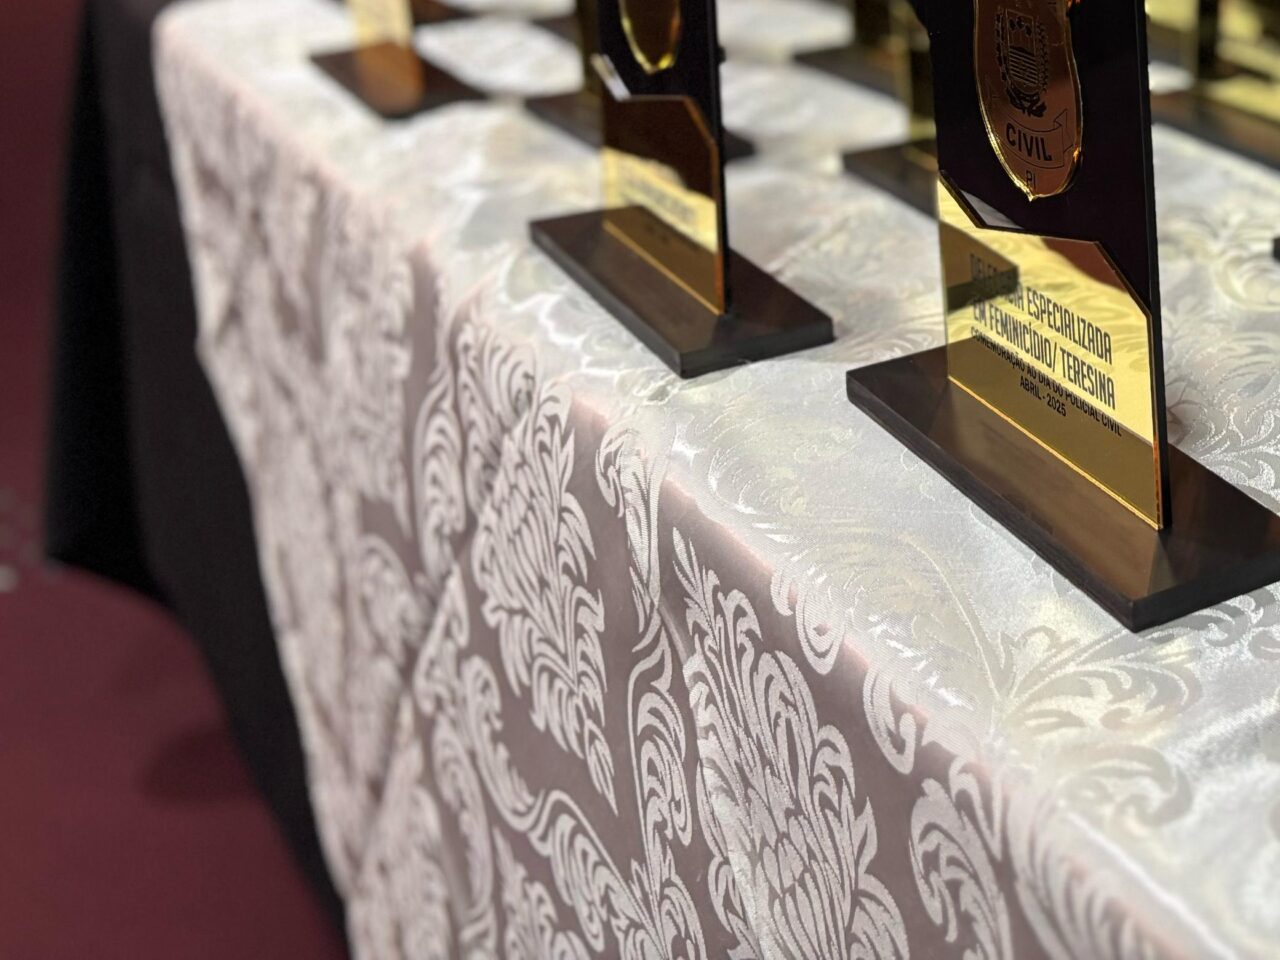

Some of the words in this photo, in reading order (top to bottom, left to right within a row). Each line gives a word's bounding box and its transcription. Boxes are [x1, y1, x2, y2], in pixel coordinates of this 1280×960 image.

[1006, 122, 1052, 162] CIVIL
[1025, 169, 1037, 190] PI
[1026, 286, 1113, 366] ESPECIALIZADA
[1019, 375, 1042, 401] ABRIL
[1046, 392, 1067, 418] 2025
[1059, 346, 1116, 411] TERESINA
[1065, 387, 1101, 423] POLICIAL
[1101, 411, 1123, 437] CIVIL
